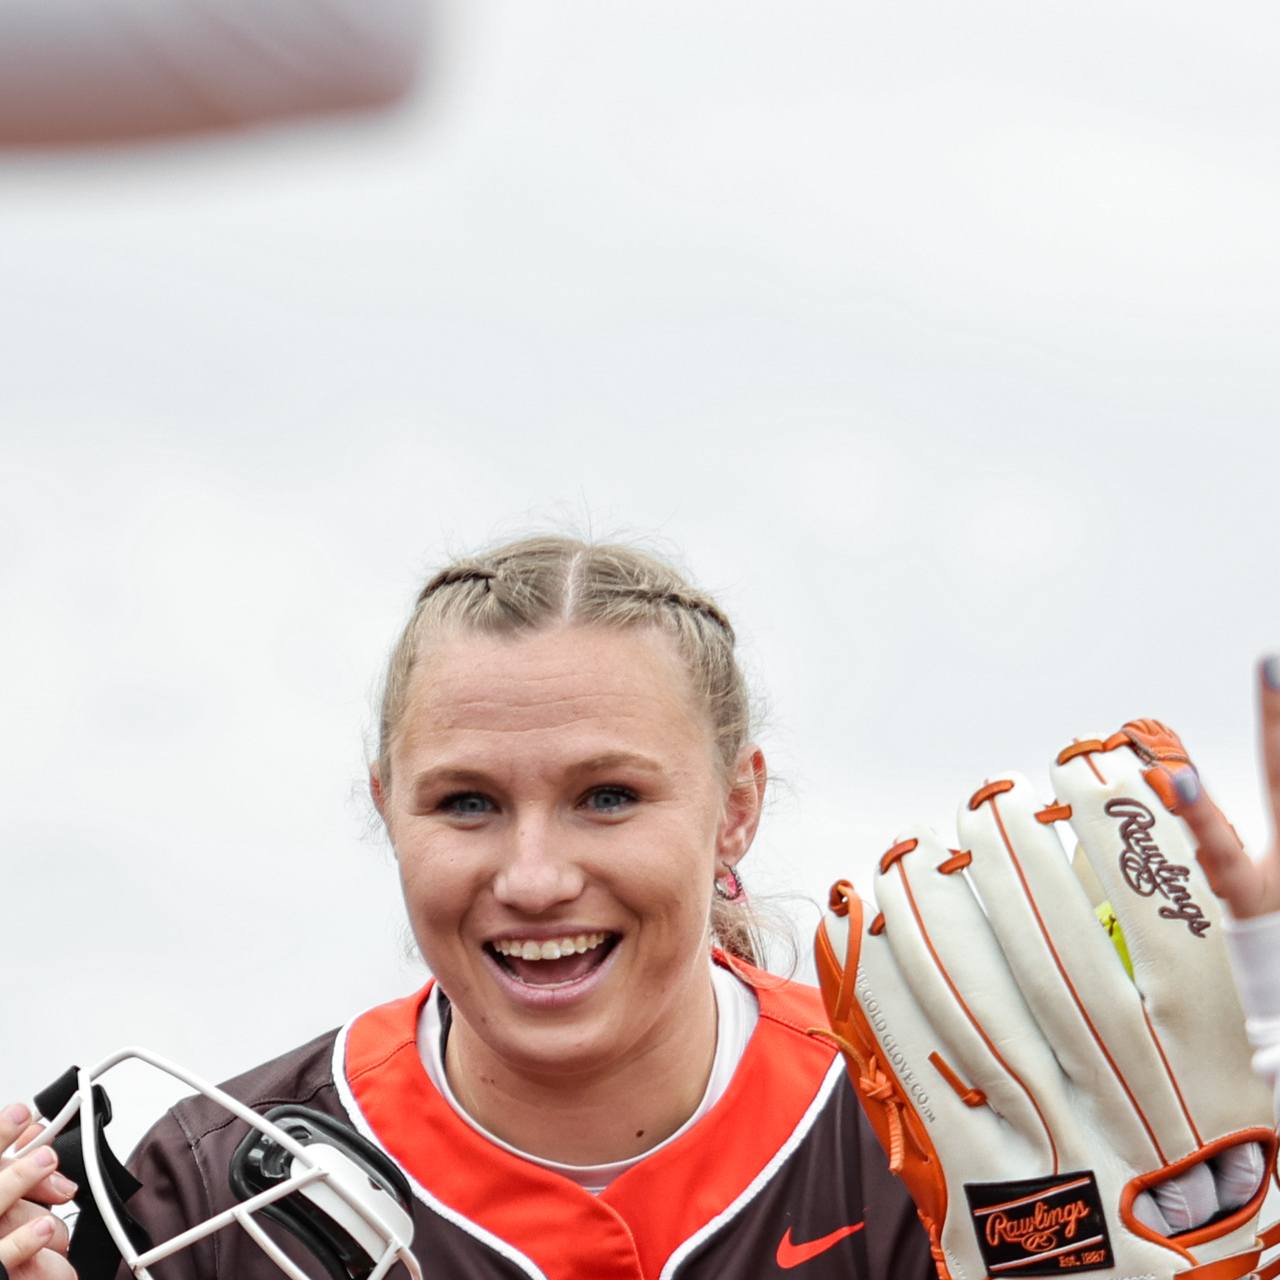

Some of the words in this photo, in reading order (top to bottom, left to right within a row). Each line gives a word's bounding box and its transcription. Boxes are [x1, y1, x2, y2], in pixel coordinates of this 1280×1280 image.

[1104, 797, 1211, 938] Rawlings
[862, 989, 887, 1033] GOLD
[882, 1032, 914, 1086] GLOVE
[985, 1200, 1090, 1247] Rawlings
[1081, 1249, 1105, 1264] 1887
